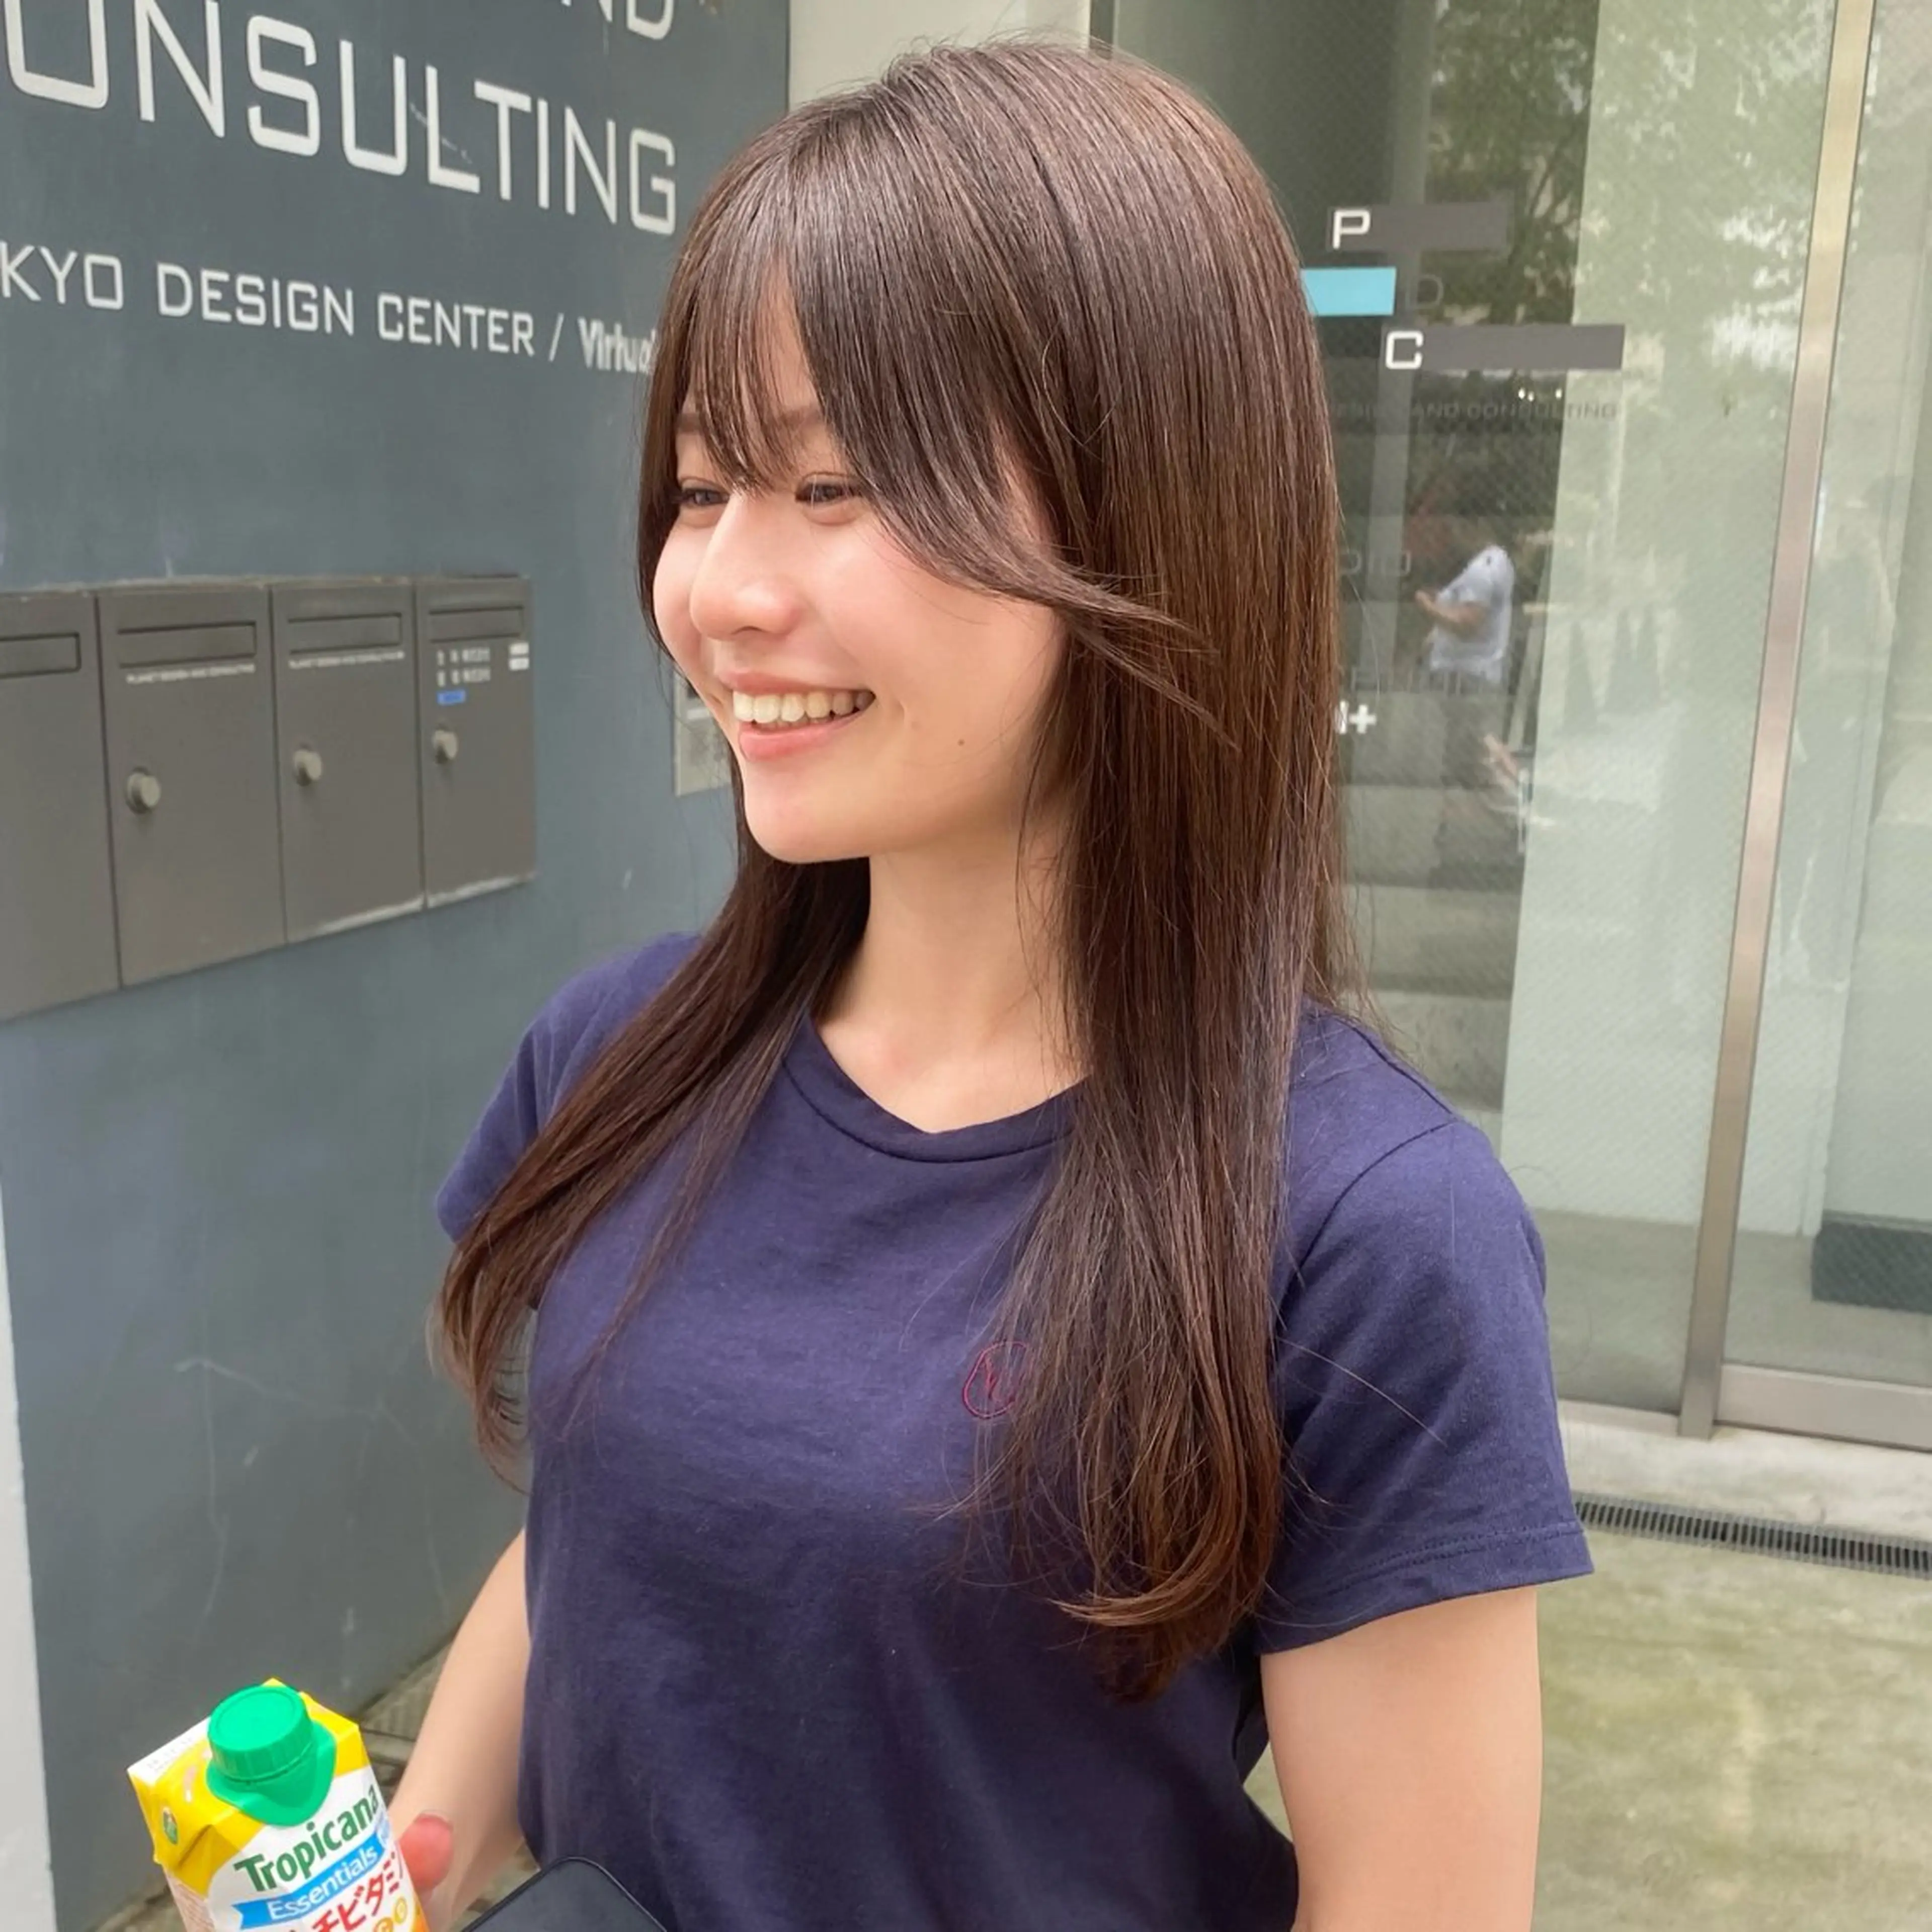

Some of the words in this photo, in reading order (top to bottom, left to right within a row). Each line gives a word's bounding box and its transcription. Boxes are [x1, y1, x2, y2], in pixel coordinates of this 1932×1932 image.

[1333, 209, 1371, 249] P
[0, 240, 124, 310] KYO
[157, 263, 354, 336] DESIGN
[378, 293, 535, 357] CENTER
[548, 312, 565, 363] /
[1385, 331, 1424, 369] C
[232, 1784, 379, 1893] Tropicana
[267, 1845, 378, 1921] Essentials
